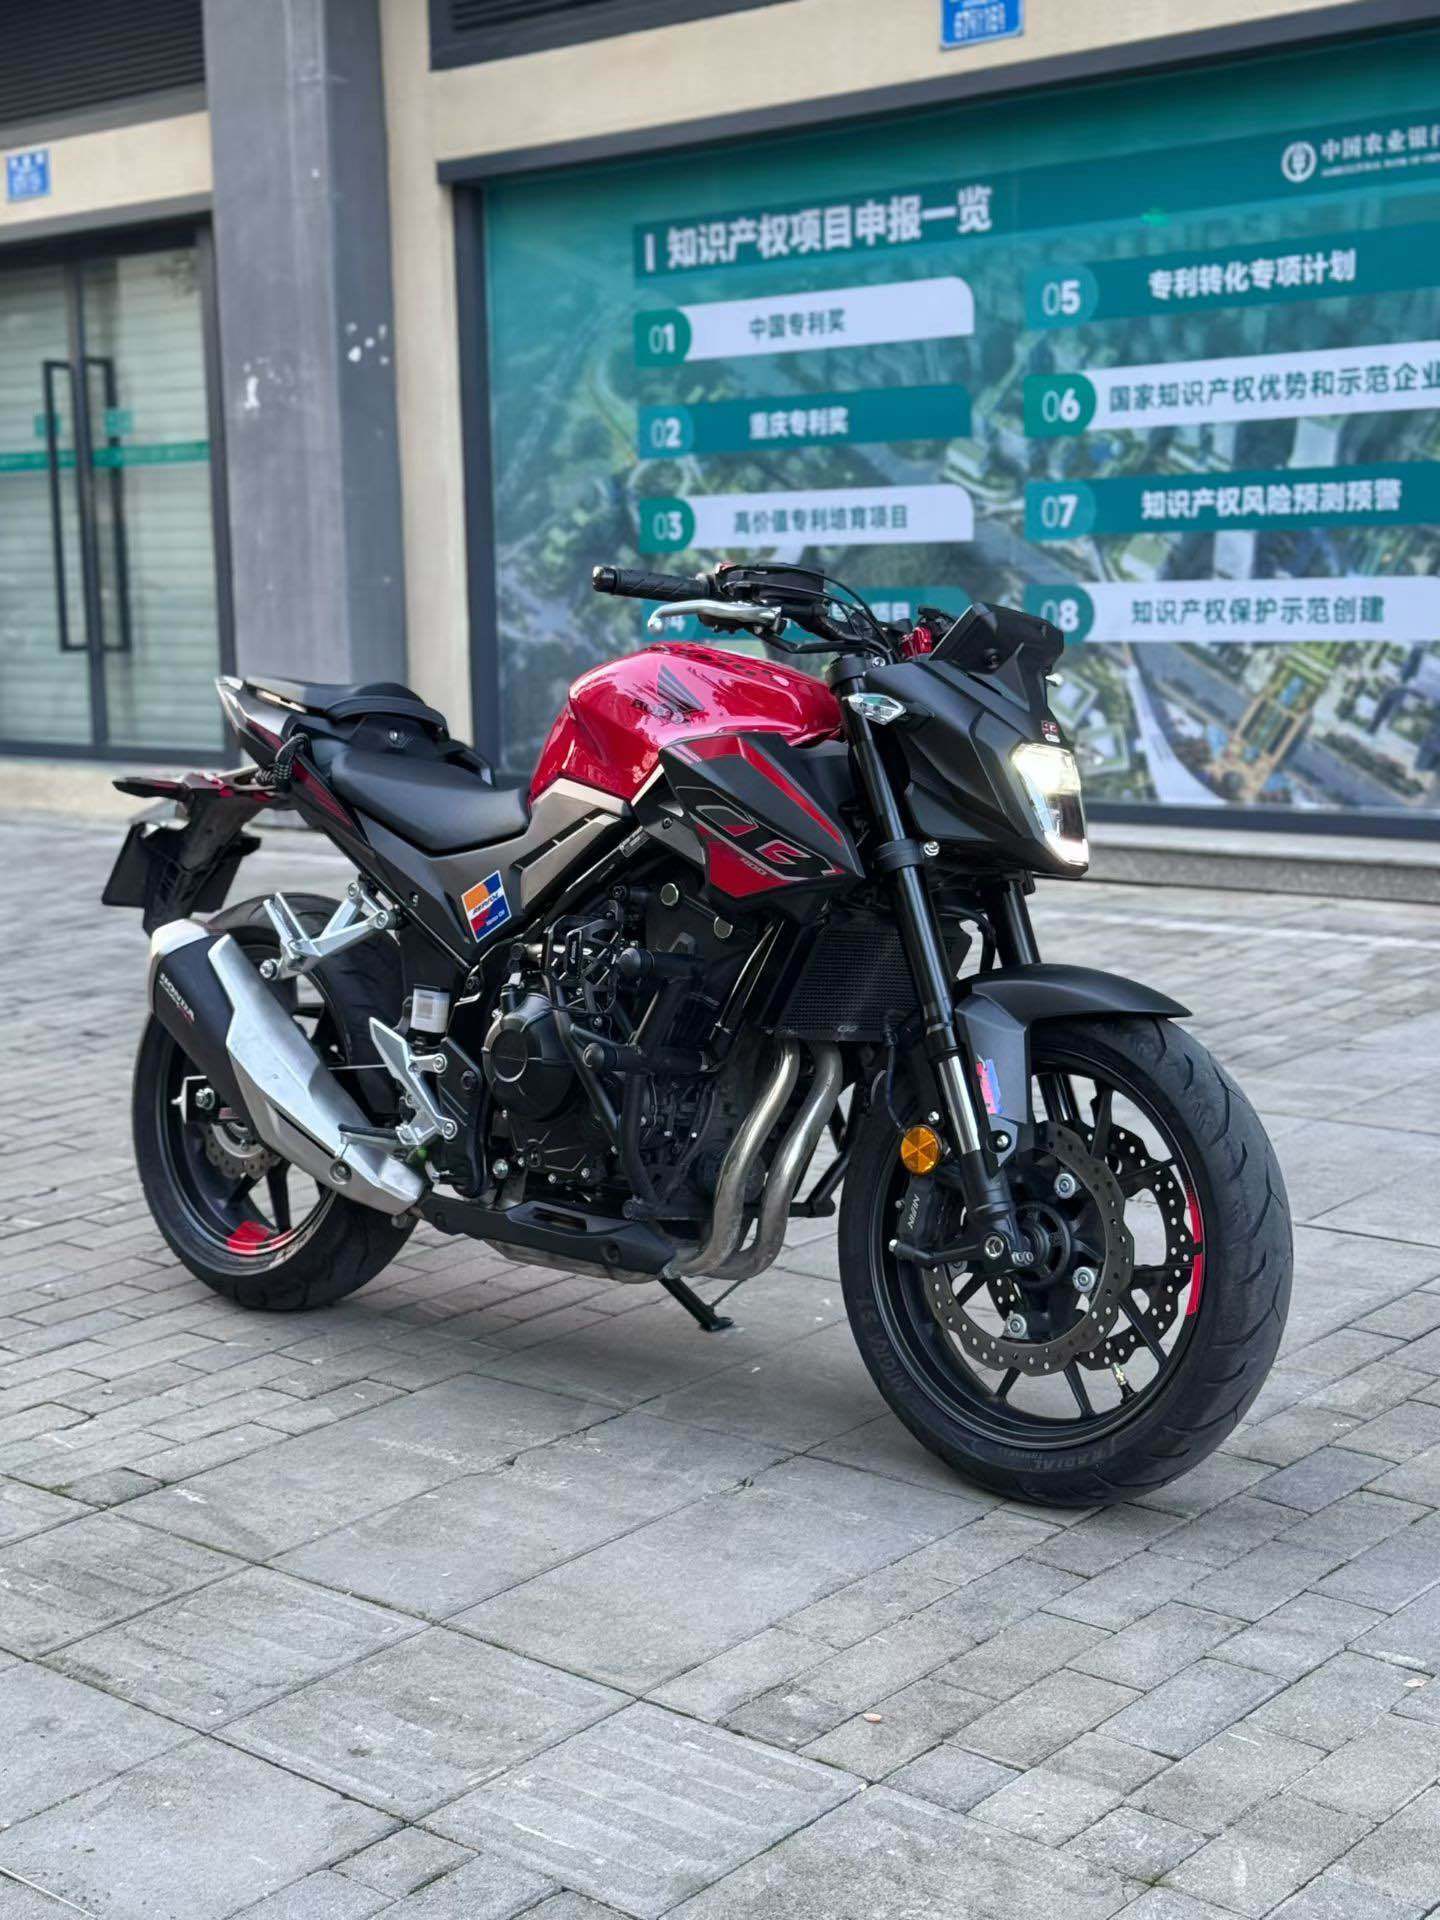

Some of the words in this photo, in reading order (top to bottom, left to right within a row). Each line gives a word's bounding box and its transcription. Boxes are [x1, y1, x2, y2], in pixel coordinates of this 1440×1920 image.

[668, 186, 992, 270] 知识产权项目申报一览
[1148, 249, 1357, 301] 专利转化专项计划
[1042, 279, 1080, 315] 05
[650, 323, 676, 354] 01
[750, 308, 847, 340] 中国专利奖
[1109, 362, 1440, 413] 国家知识产权优势和示范企业
[750, 405, 849, 440] 重庆专利奖
[1042, 388, 1080, 423] 06
[651, 417, 682, 448] 02
[1041, 494, 1079, 528] 07
[1141, 478, 1403, 520] 知识产权风险预测预警
[653, 510, 683, 541] 03
[1040, 599, 1080, 633] 08
[1131, 596, 1386, 626] 知识产权保护示范创建
